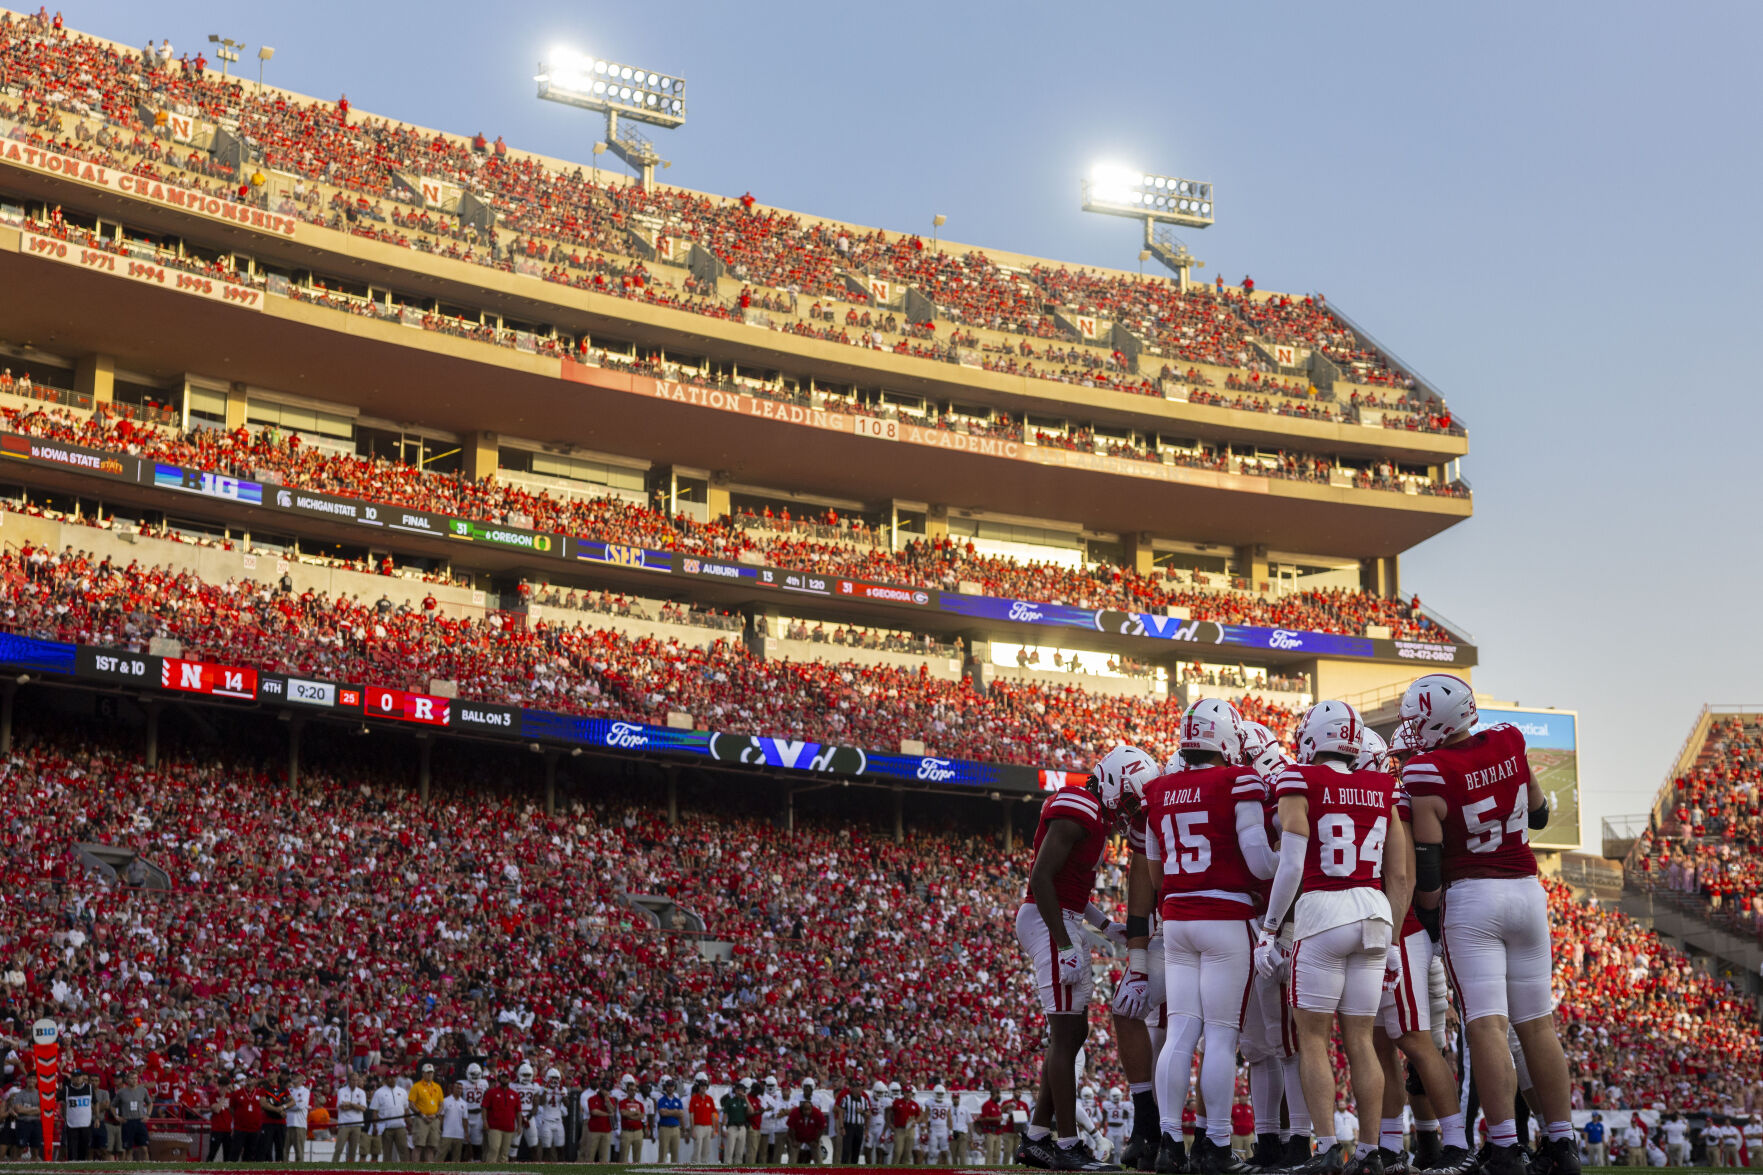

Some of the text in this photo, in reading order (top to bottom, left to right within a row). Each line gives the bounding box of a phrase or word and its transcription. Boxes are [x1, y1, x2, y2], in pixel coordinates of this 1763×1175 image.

[172, 117, 189, 138] N
[423, 184, 439, 203] N
[119, 176, 295, 235] CHAMPIONSHIPS
[29, 237, 258, 305] 1970 1971 1994 1995 1997
[872, 283, 886, 299] N
[1080, 319, 1093, 335] N
[1278, 349, 1292, 363] N
[656, 381, 740, 411] NATION
[751, 399, 843, 429] LEADING
[859, 419, 896, 438] 108
[910, 428, 1017, 457] ACADEMIC
[40, 447, 68, 460] IOWA
[70, 453, 100, 468] STATE
[297, 496, 376, 519] MICHIGAN STATE 10
[402, 515, 430, 528] FINAL
[456, 522, 467, 535] 31
[485, 531, 491, 540] 6
[492, 532, 532, 546] OREGON
[703, 564, 738, 578] AUBURN
[763, 571, 773, 582] 13
[786, 576, 825, 590] 4th 1:20
[842, 582, 853, 593] 31
[872, 588, 911, 601] GEORGIA
[96, 655, 145, 676] 1ST & 10
[181, 664, 242, 691] N 14
[262, 681, 281, 694] 4TH
[297, 685, 325, 700] 9:20
[343, 693, 354, 703] 25
[1419, 692, 1432, 712] N
[381, 694, 433, 719] 0 R
[462, 710, 511, 726] BALL ON 3
[1340, 726, 1361, 743] 84
[1044, 770, 1067, 791] N
[1465, 756, 1519, 791] BENHART
[1163, 787, 1201, 806] RAIOLA
[1322, 787, 1385, 808] A. BULLOCK
[1461, 783, 1529, 853] 54
[1161, 811, 1211, 875] 15
[1317, 813, 1388, 878] 84
[466, 1091, 482, 1104] 82
[932, 1108, 947, 1120] 38
